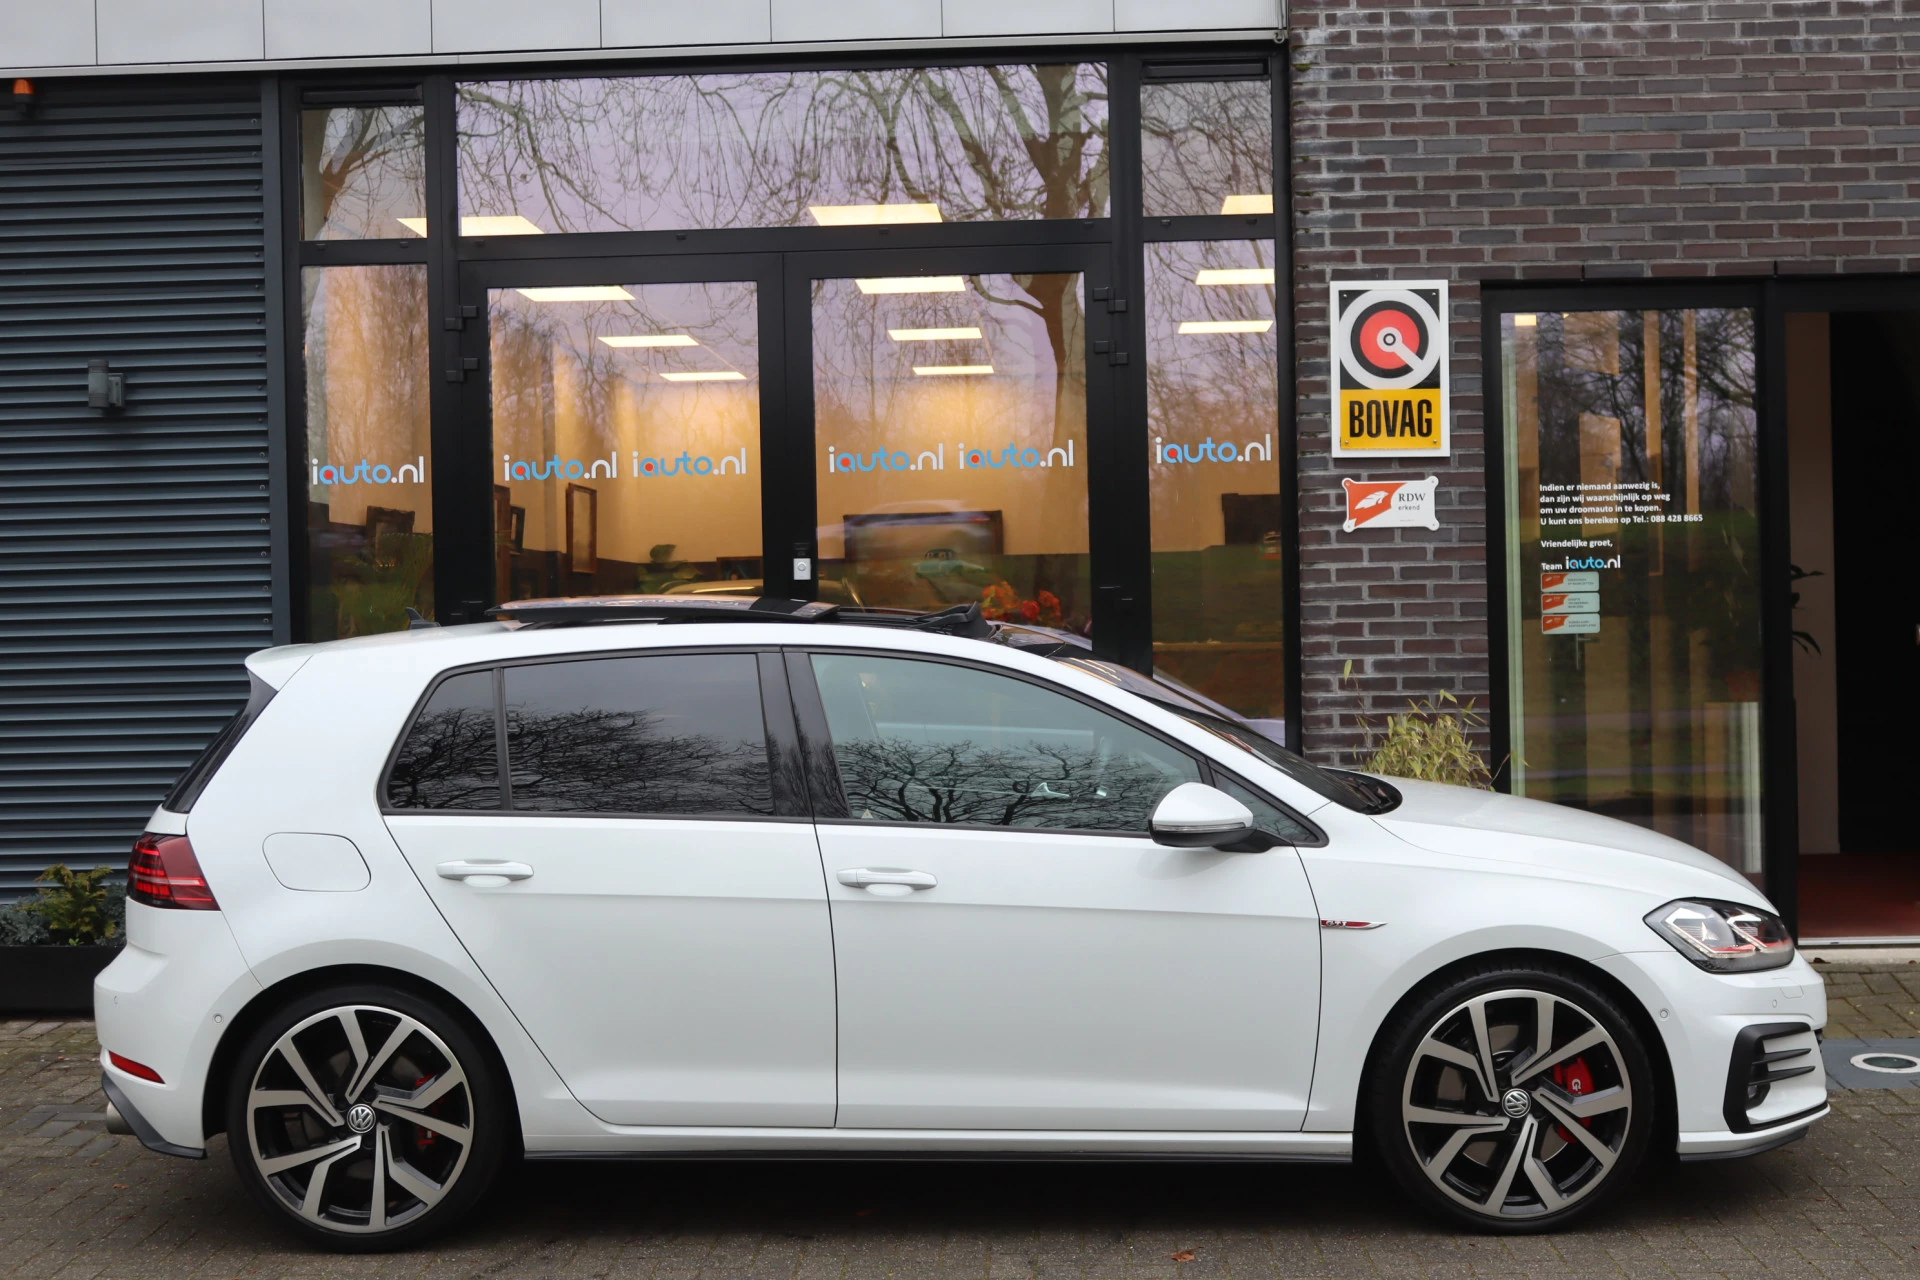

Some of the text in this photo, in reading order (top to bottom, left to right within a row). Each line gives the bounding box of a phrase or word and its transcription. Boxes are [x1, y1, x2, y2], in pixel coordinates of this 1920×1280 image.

[1349, 399, 1432, 438] BOVAG
[1156, 434, 1271, 464] iauto.nl
[828, 440, 1074, 473] iauto.nl iauto.nl
[312, 456, 425, 485] iauto.nl
[503, 448, 746, 481] iauto.nl iauto.nl
[1576, 483, 1611, 491] niemand
[1613, 482, 1649, 491] aanwezig
[1651, 482, 1660, 490] is,
[1399, 493, 1426, 502] RDW
[1540, 493, 1670, 504] dan zijn wij waarschijnlijk op weg
[1569, 505, 1613, 513] droomauto
[1635, 504, 1661, 513] kopen.
[1549, 517, 1567, 525] kunt
[1585, 516, 1618, 524] bereiken
[1621, 517, 1631, 525] op
[1651, 515, 1665, 523] 088
[1683, 514, 1703, 522] 8665
[1541, 539, 1613, 549] Vriendelijke groet,
[1541, 555, 1621, 571] Team iauto.nl
